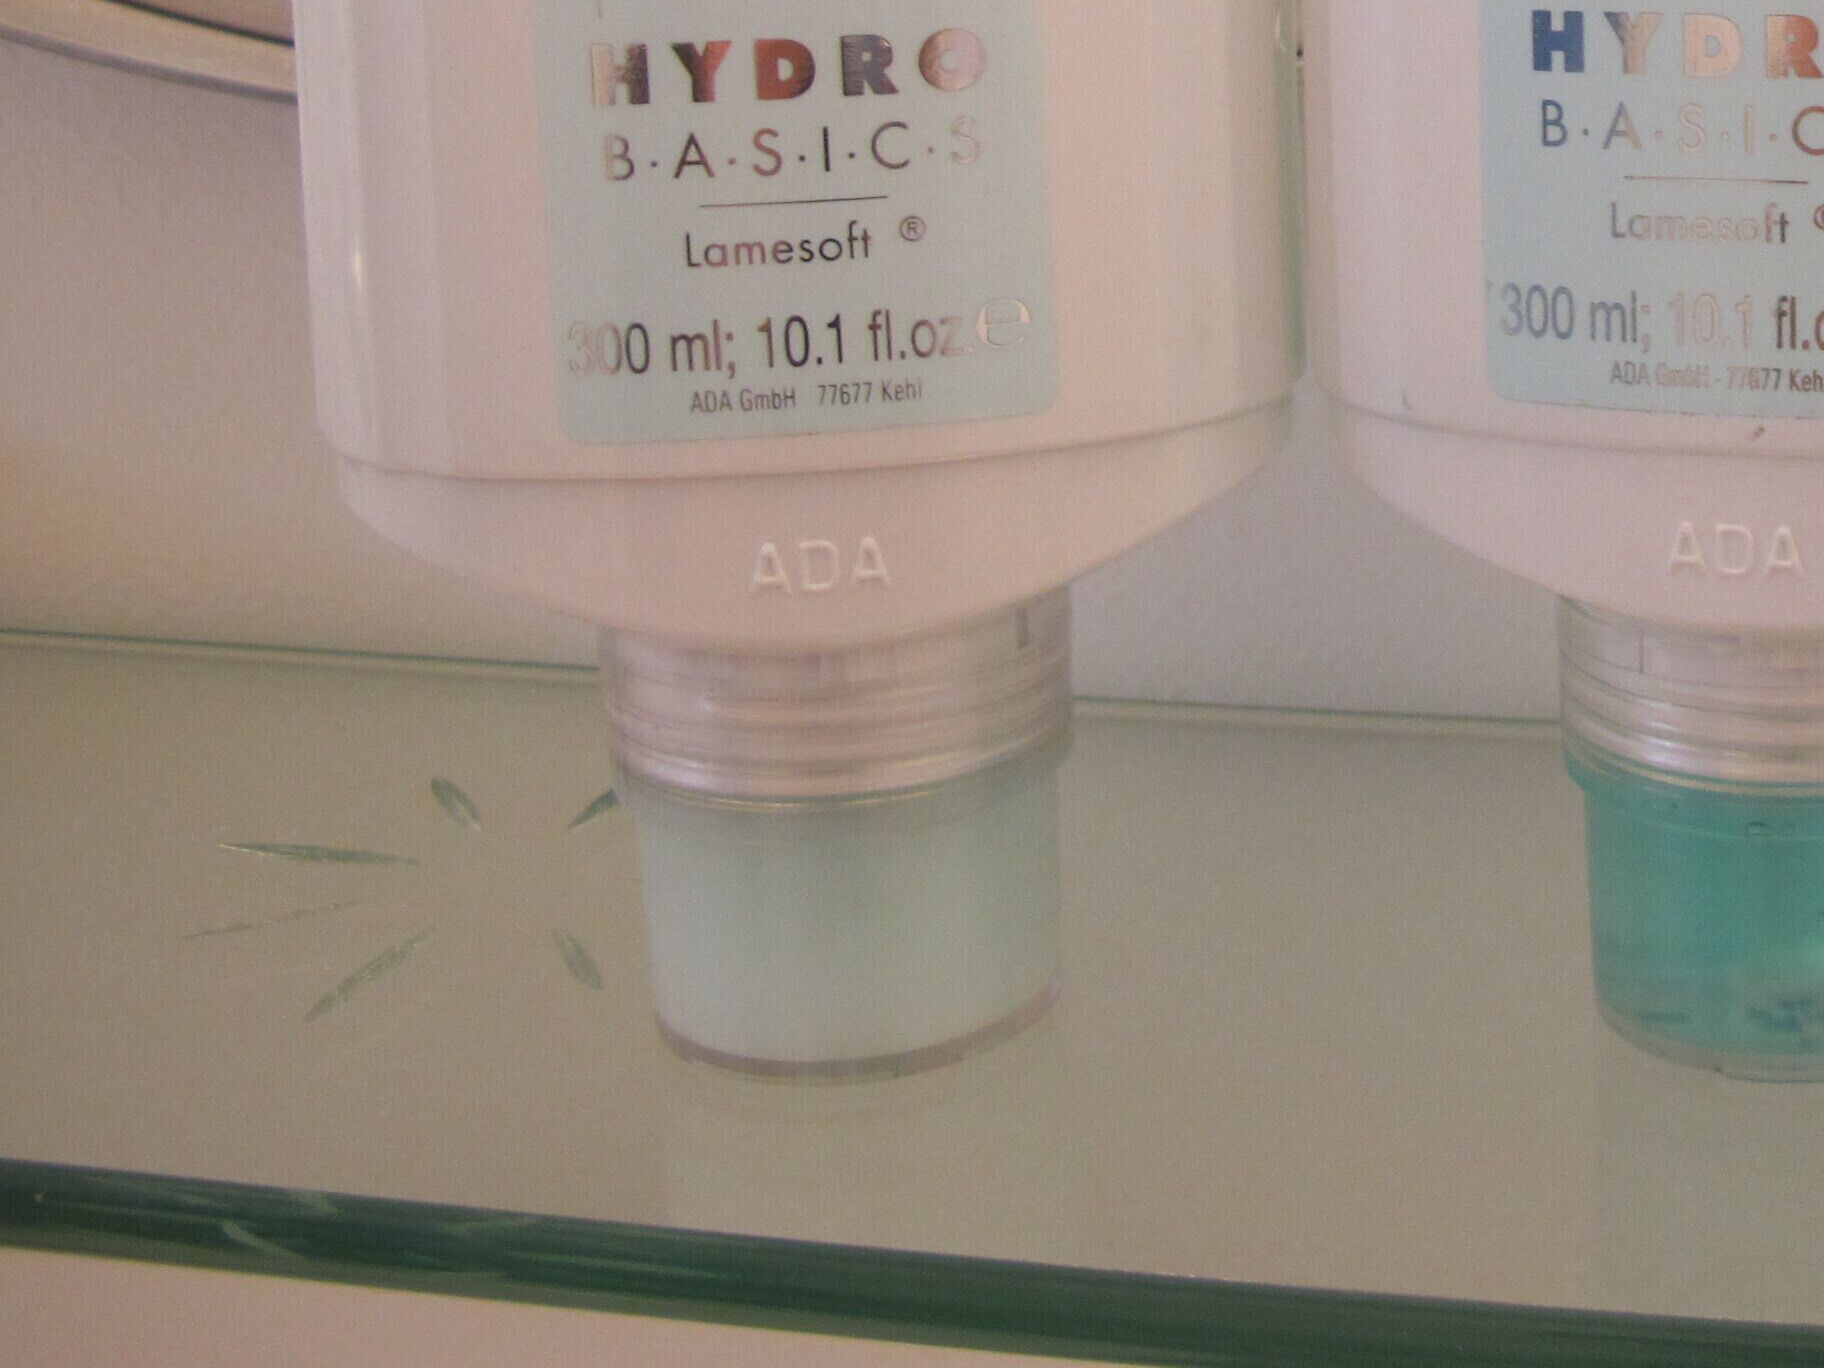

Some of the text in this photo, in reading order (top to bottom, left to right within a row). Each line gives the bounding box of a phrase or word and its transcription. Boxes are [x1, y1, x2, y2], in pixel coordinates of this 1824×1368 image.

[590, 28, 988, 105] HYDRO
[686, 220, 873, 268] Lamesoft
[1610, 201, 1790, 246] Lamesoft
[1501, 282, 1575, 340] 300
[1590, 290, 1651, 353] ml;
[1669, 291, 1753, 349] 10.1
[567, 320, 651, 376] 300
[671, 318, 737, 379] ml;
[758, 313, 843, 368] 10.1
[690, 379, 923, 414] ADA GmbH 77677 Kehl
[1610, 361, 1649, 386] ADA
[1655, 363, 1710, 389] GmbH
[1727, 367, 1782, 391] 77677
[750, 536, 892, 594] ADA
[1668, 520, 1802, 576] ADA
